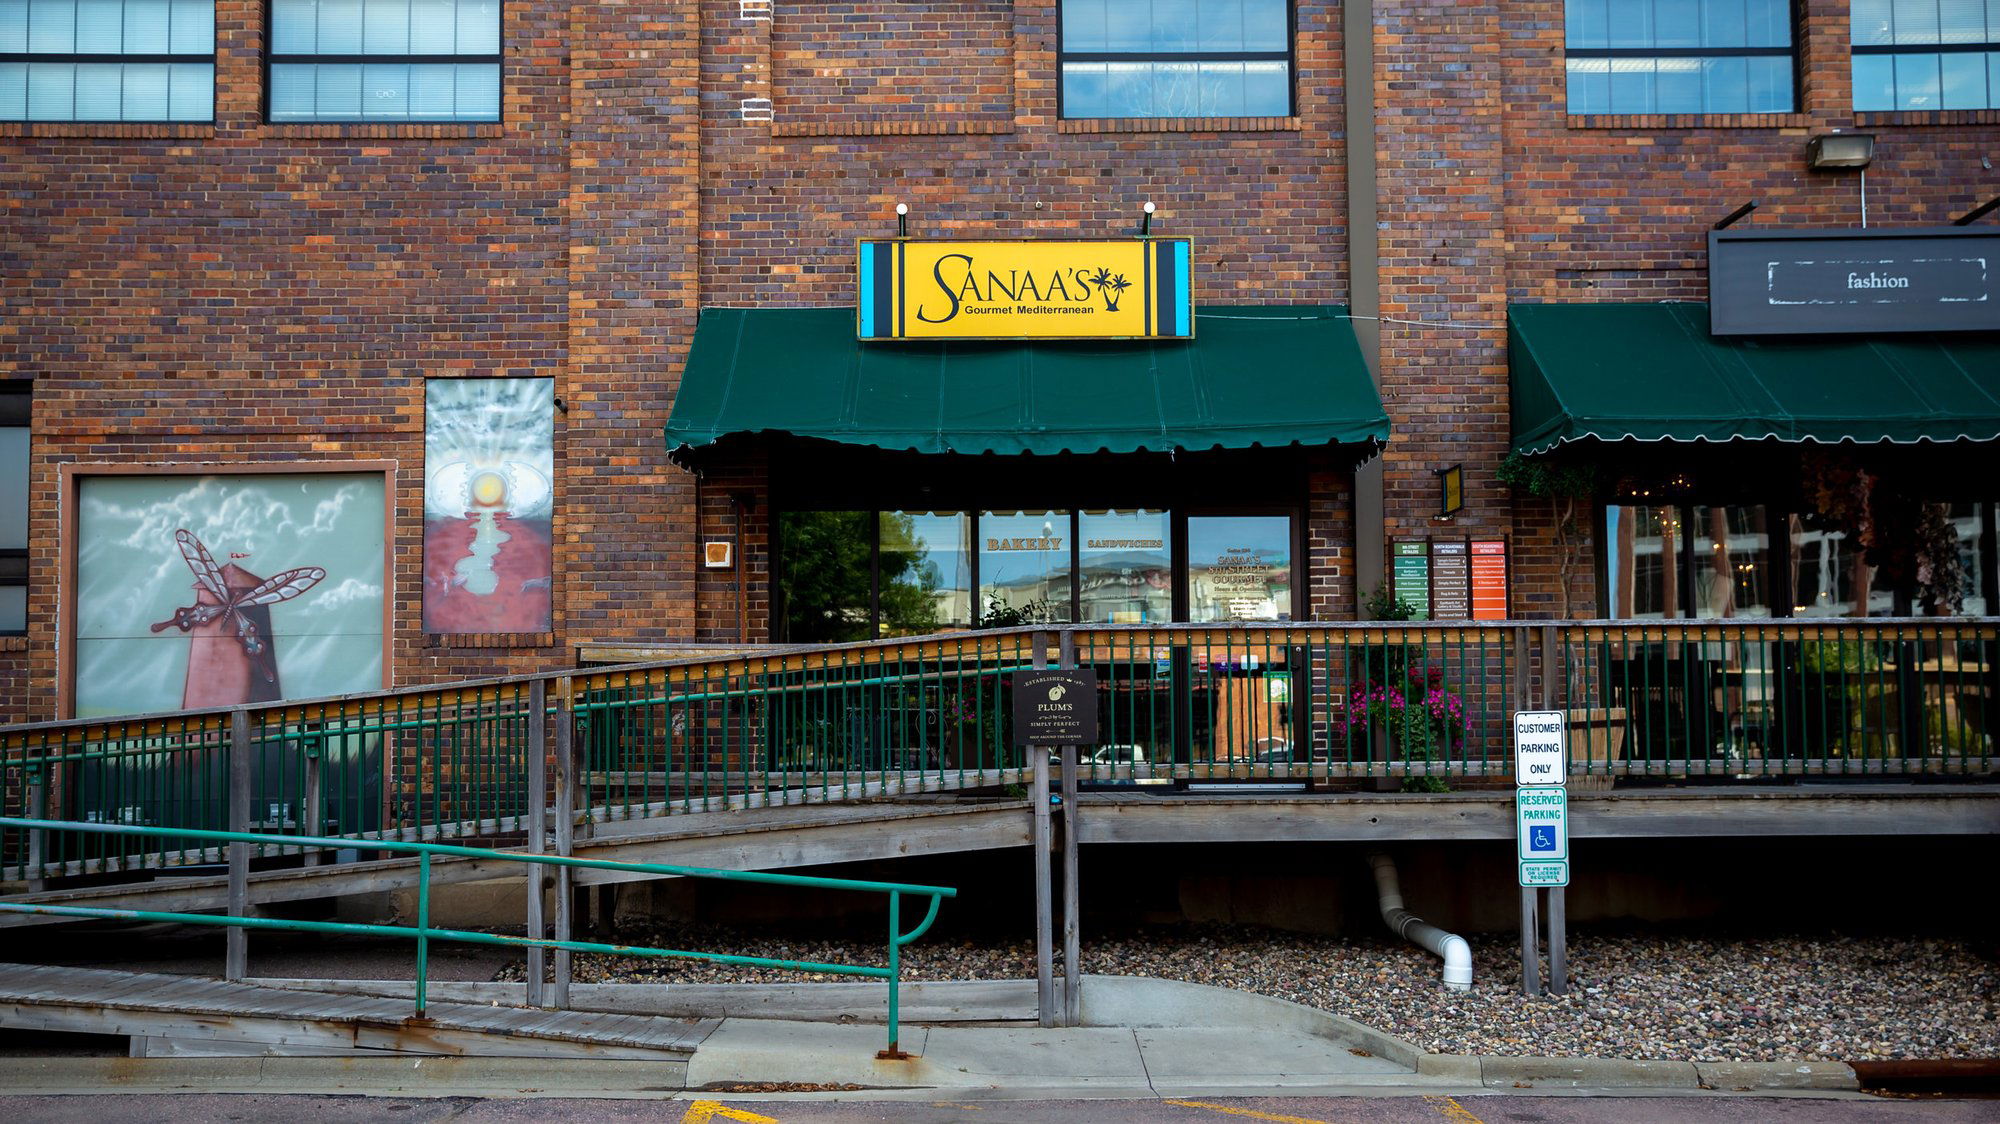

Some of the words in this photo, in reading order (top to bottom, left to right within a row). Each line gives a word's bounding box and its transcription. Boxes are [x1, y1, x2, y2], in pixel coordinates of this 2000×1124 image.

[1847, 272, 1909, 289] fashion
[917, 254, 1092, 324] SANAA'S
[965, 305, 1013, 315] Gourmet
[1017, 305, 1094, 315] Mediterranean
[986, 538, 1063, 551] BAKERY
[1087, 539, 1164, 549] SANDWICHES
[1024, 676, 1065, 687] ESTABLISHED
[1038, 703, 1073, 711] PLUM'S
[1518, 723, 1561, 734] CUSTOMER
[1520, 743, 1560, 753] PARKING
[1530, 764, 1552, 774] ONLY
[1520, 795, 1563, 805] RESERVED
[1523, 810, 1561, 820] PARKING
